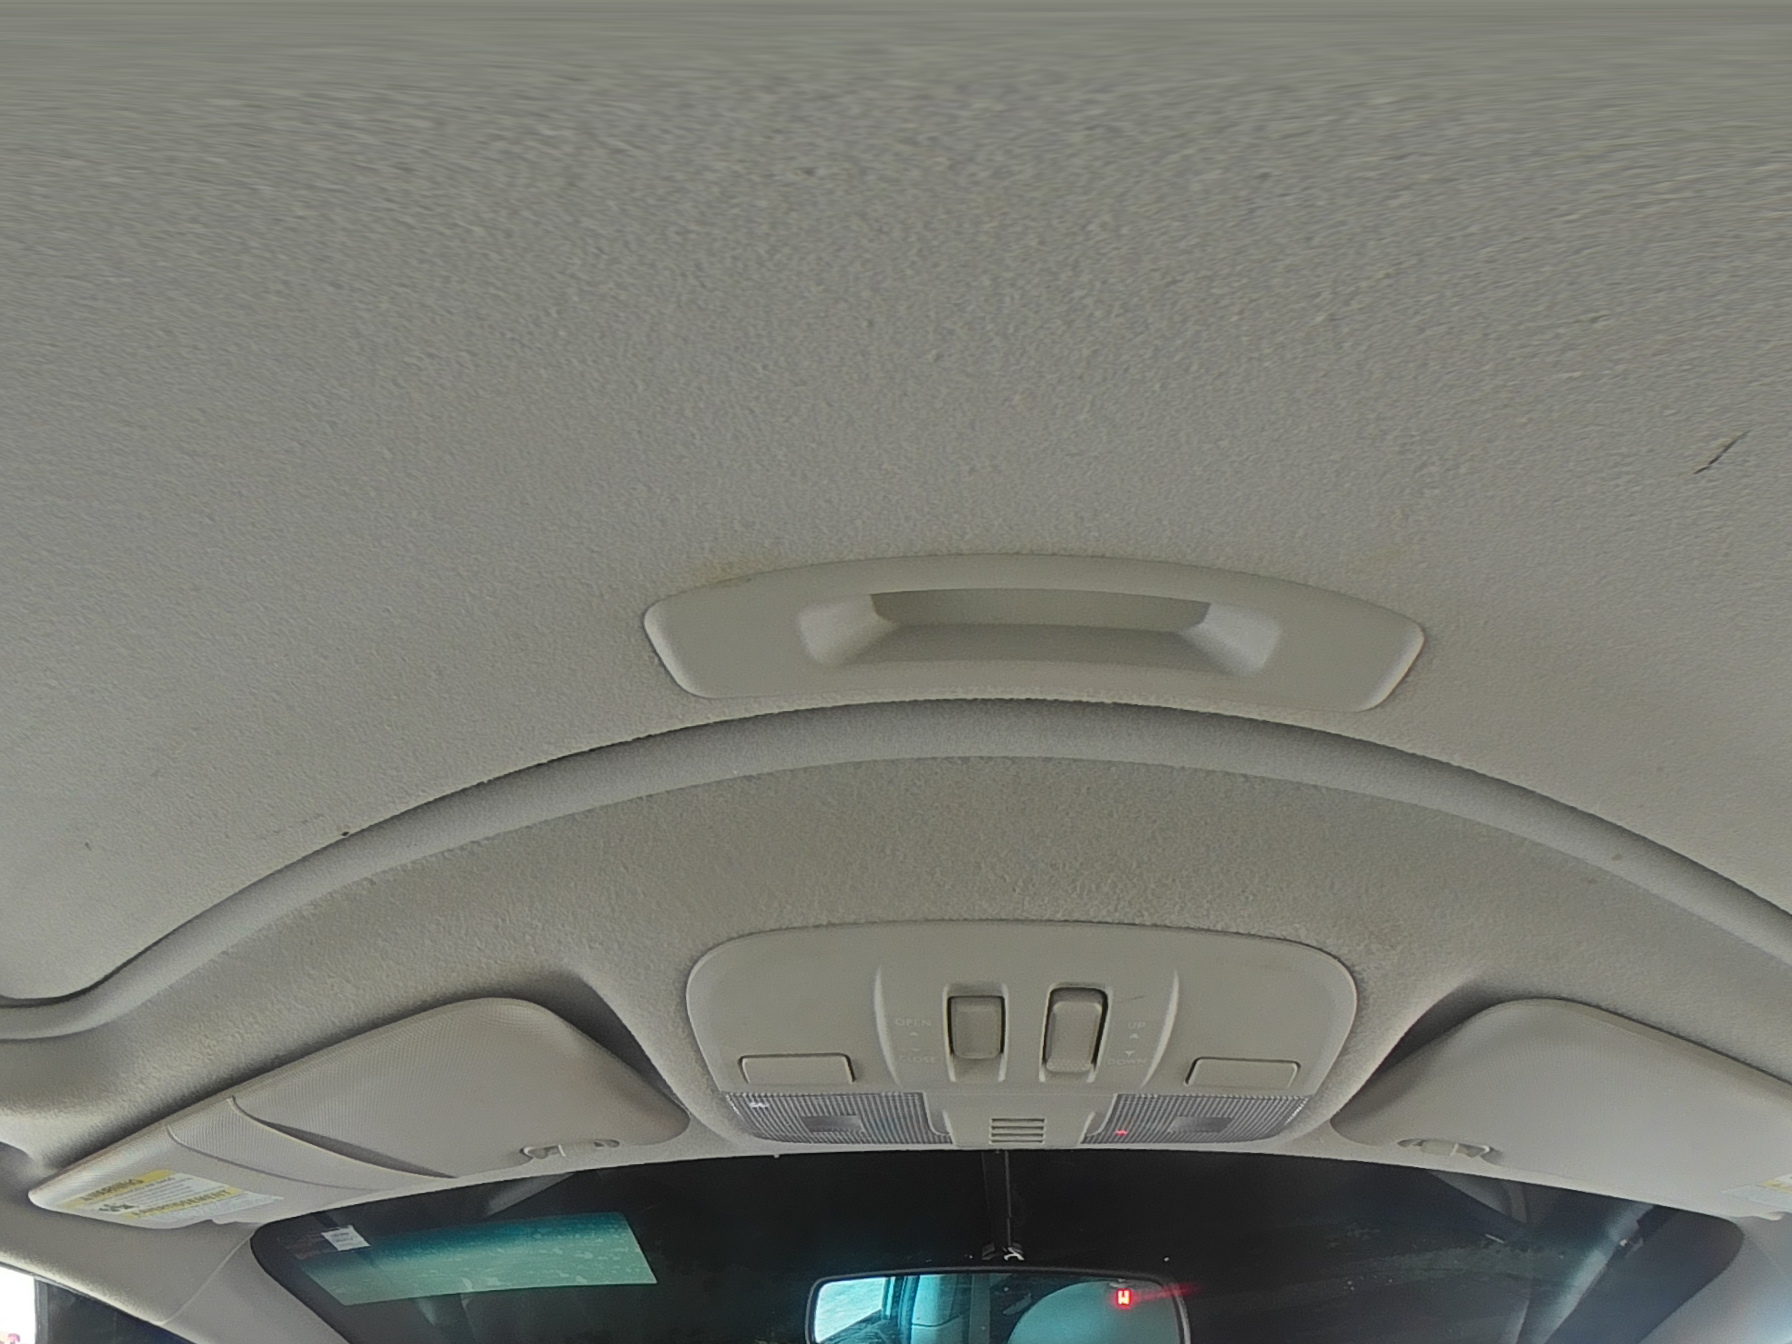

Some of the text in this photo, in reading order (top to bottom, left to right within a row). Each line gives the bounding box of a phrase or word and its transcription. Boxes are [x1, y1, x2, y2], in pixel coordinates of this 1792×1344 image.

[894, 1018, 932, 1027] OPEN
[1128, 1021, 1147, 1030] UP
[1107, 1058, 1148, 1066] DOWN
